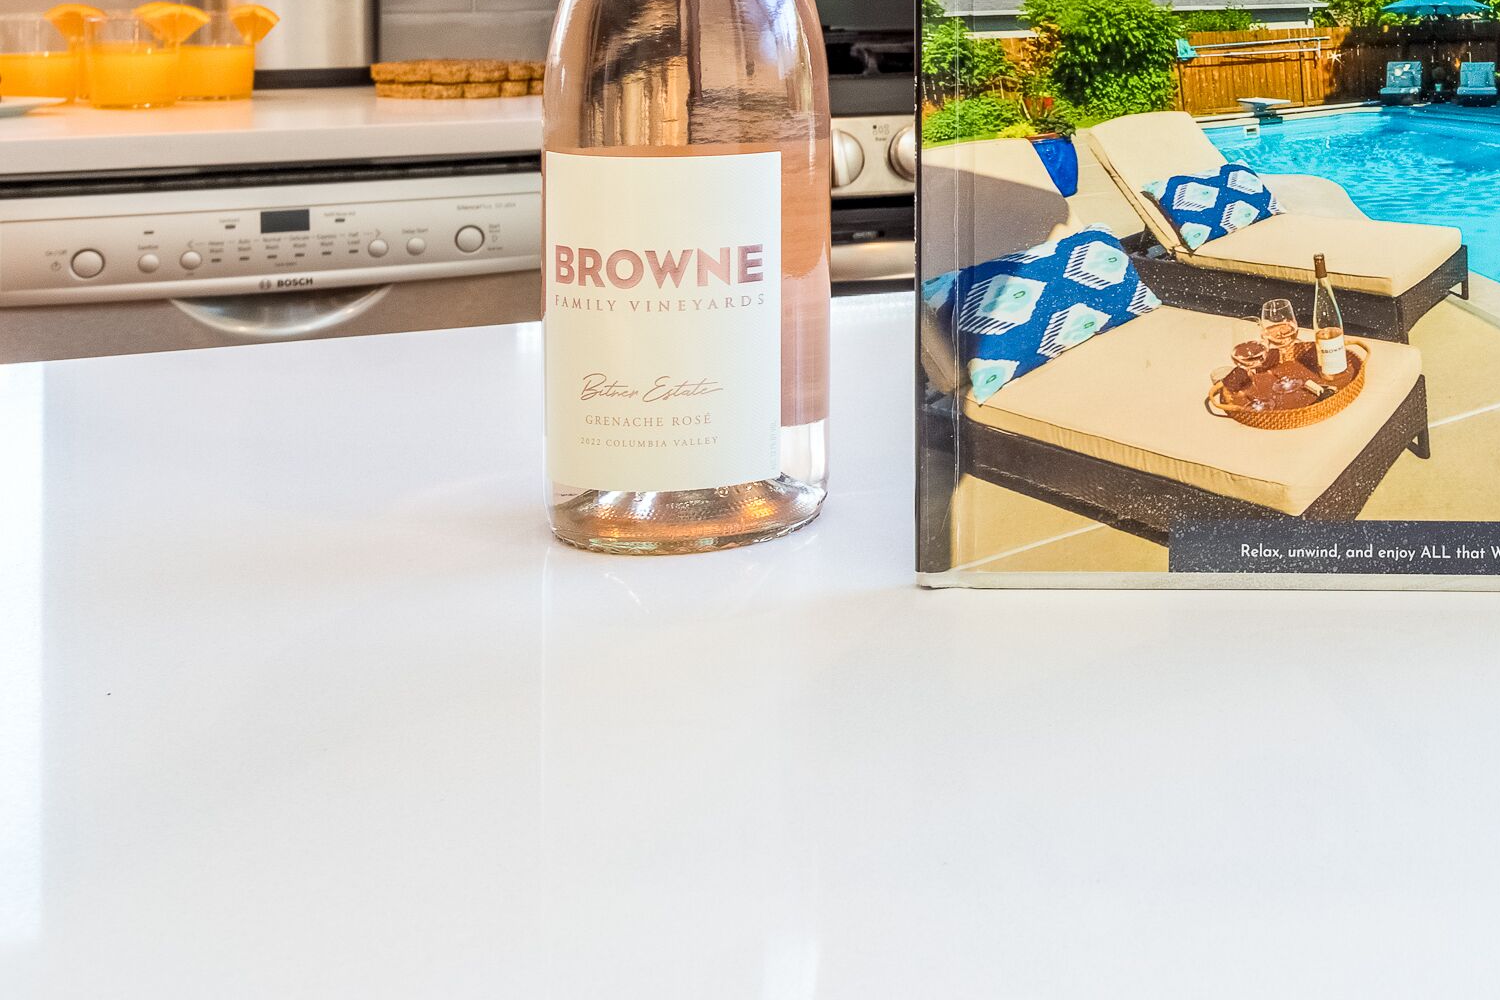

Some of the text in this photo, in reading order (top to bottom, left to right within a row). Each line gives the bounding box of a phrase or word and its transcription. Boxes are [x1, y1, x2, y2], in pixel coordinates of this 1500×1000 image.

[554, 243, 764, 290] BROWNE
[277, 278, 314, 288] BOSCH
[554, 293, 765, 313] FAMILY VINEYARDS
[580, 372, 724, 403] Bitner Estate
[585, 411, 713, 428] GRENACHE ROSÉ
[605, 438, 668, 448] COLUMBIA
[672, 435, 719, 448] VALLEY
[1240, 543, 1283, 559] Relax,
[1288, 543, 1341, 559] unwind,
[1345, 543, 1374, 559] and
[1378, 546, 1416, 561] enjoy
[1420, 545, 1451, 559] ALL
[1455, 544, 1486, 559] that
